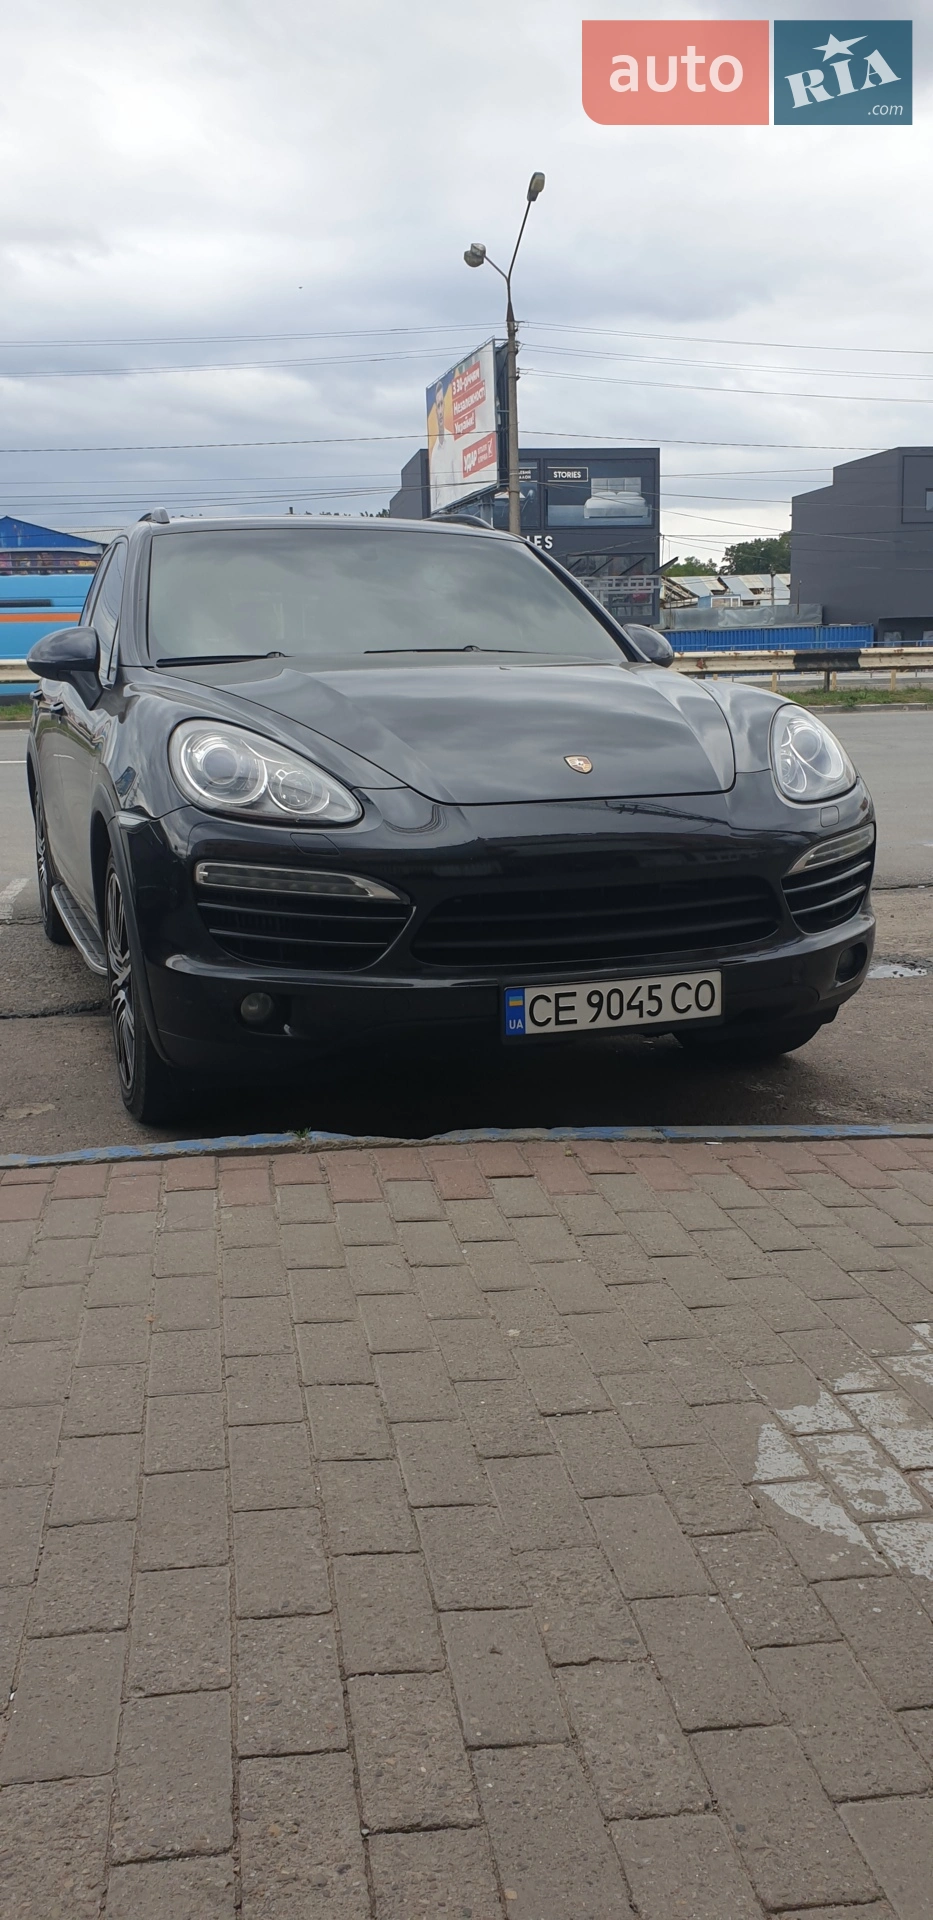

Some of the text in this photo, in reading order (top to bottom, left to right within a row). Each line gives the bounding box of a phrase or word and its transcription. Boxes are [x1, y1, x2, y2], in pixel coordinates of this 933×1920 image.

[463, 448, 477, 473] УДАР
[553, 470, 582, 479] STORIES
[528, 979, 716, 1027] CE 9045 CO
[509, 1019, 524, 1030] UA
